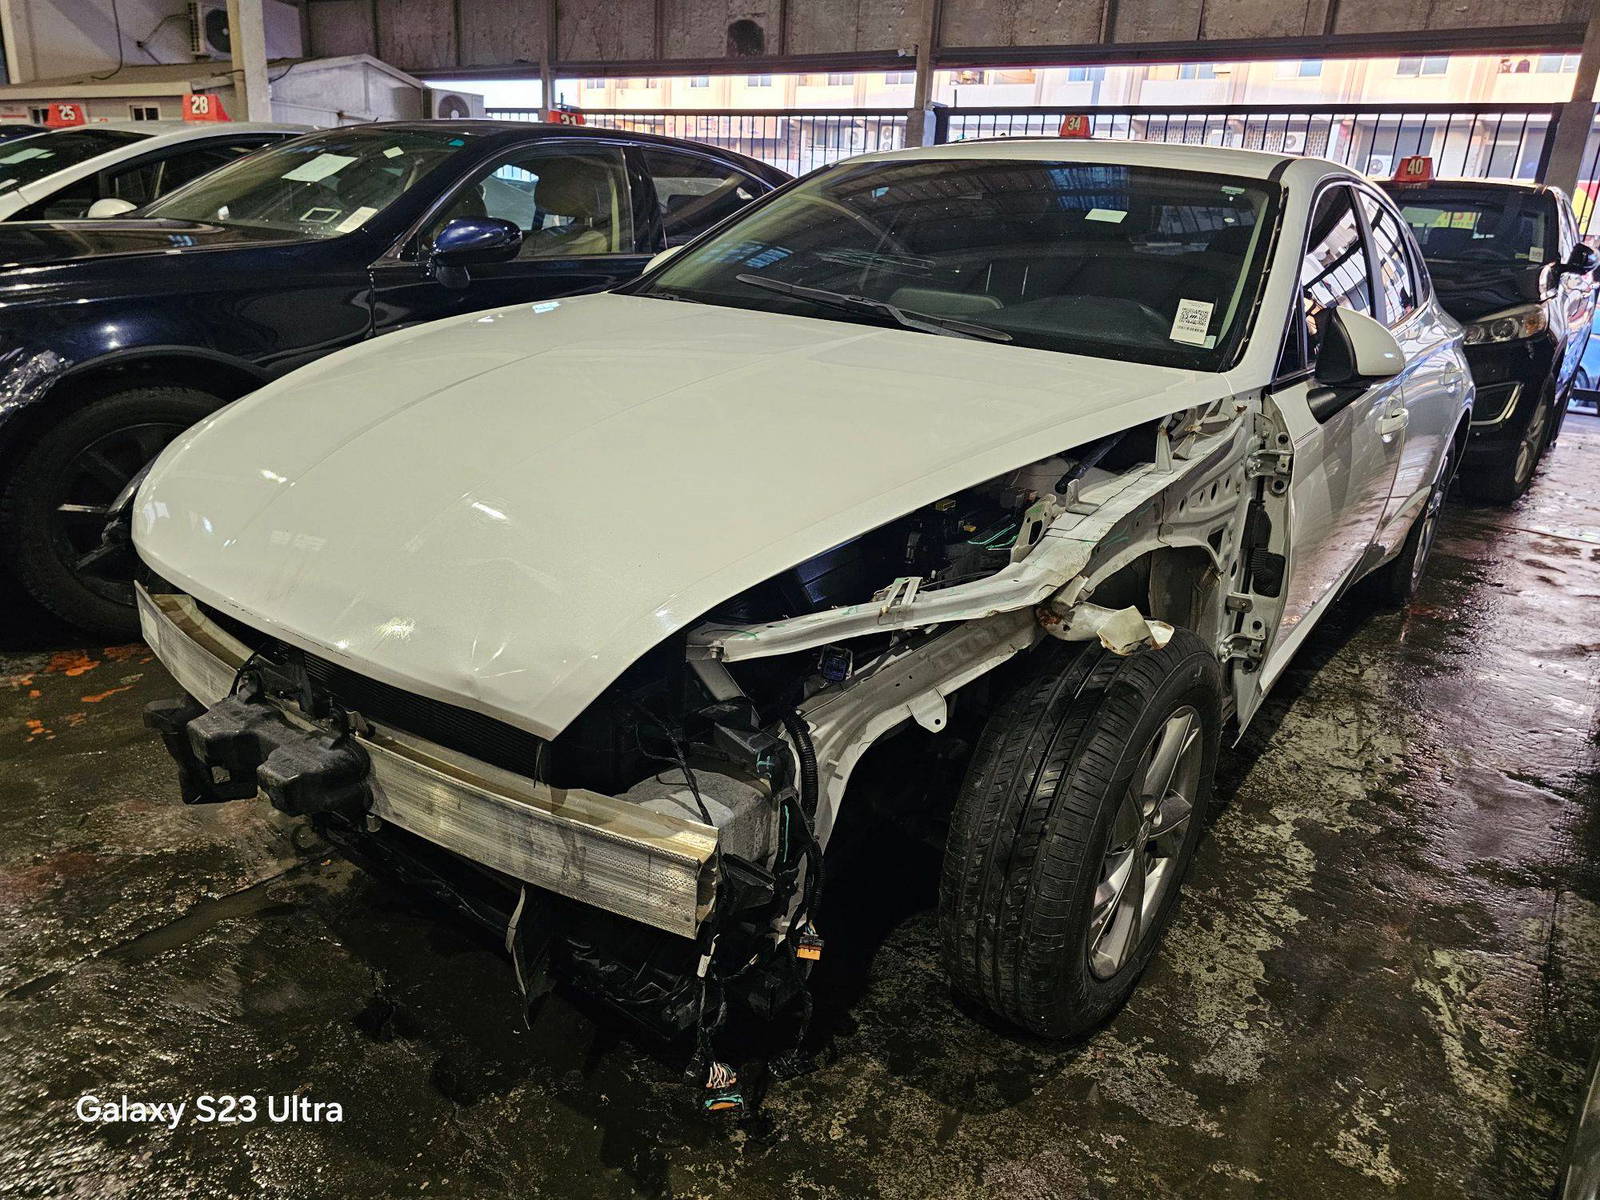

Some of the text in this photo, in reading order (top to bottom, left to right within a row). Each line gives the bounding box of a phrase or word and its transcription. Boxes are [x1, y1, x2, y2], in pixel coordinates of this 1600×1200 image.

[191, 95, 209, 114] 28
[59, 105, 76, 121] 25
[1068, 116, 1082, 131] 34
[1407, 159, 1424, 175] 40
